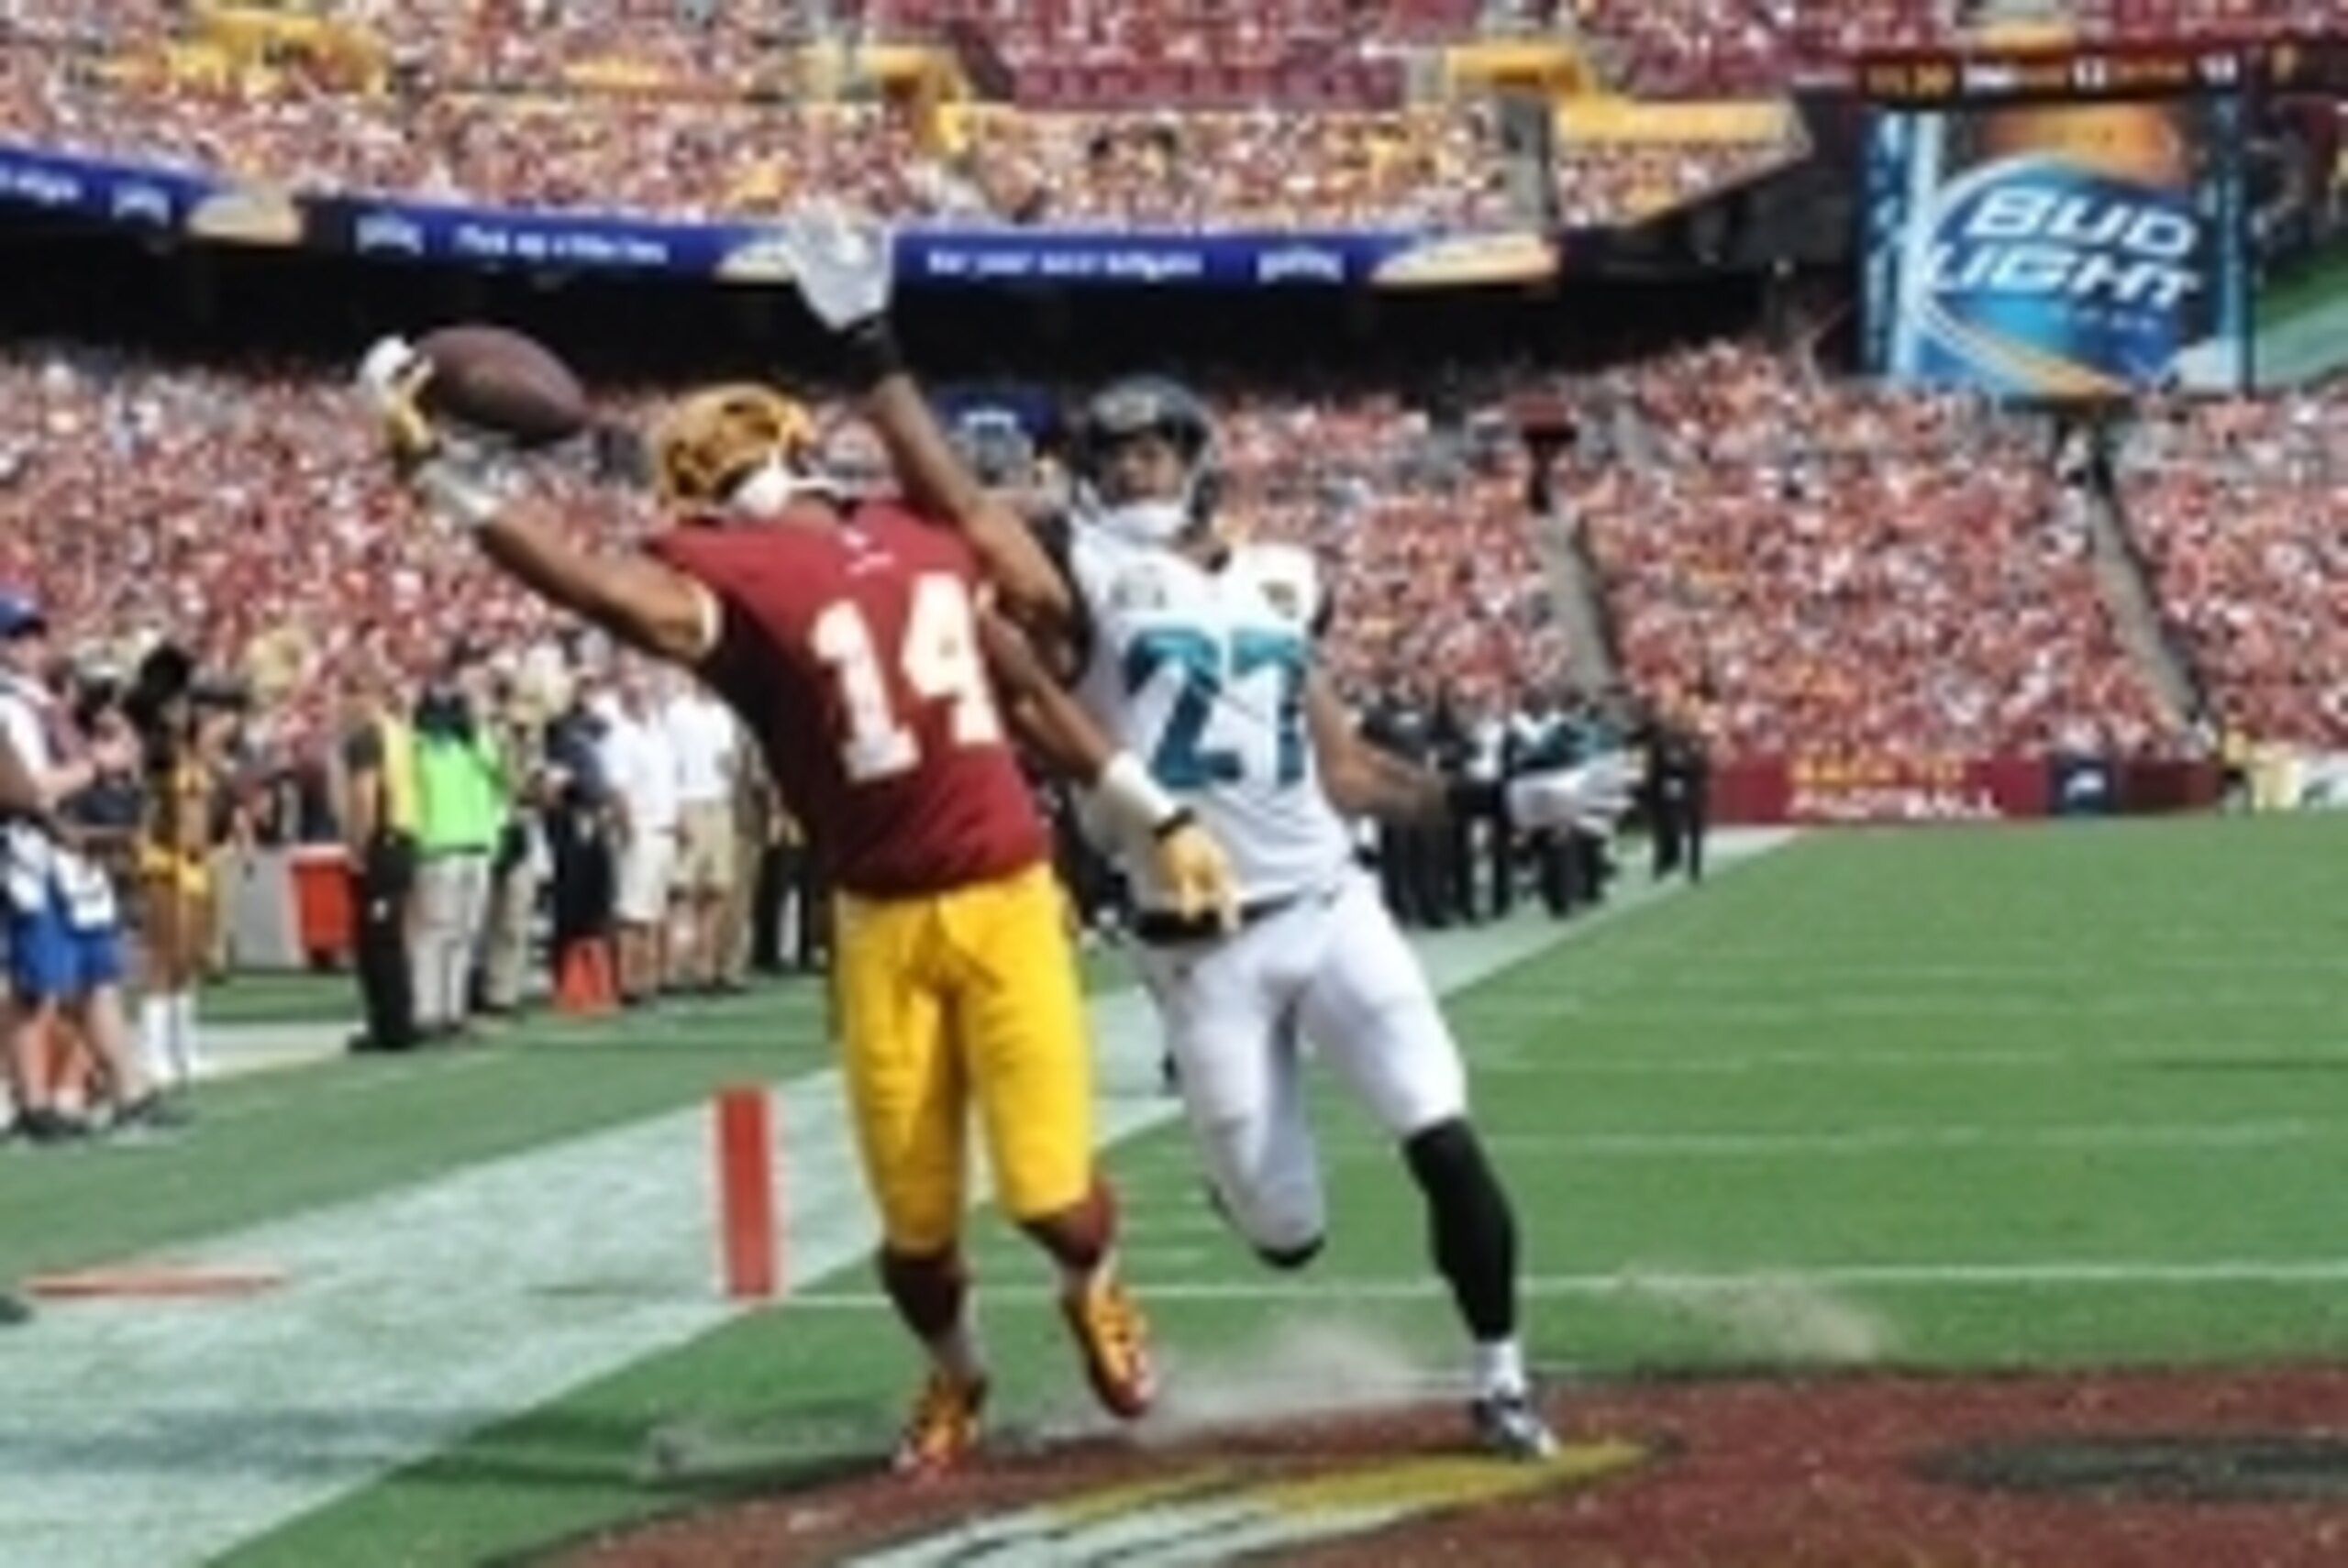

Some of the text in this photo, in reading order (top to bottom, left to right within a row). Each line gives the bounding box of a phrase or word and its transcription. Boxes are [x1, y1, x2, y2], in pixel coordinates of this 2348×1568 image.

[1928, 242, 2201, 309] LIGHT
[1963, 187, 2199, 256] BUD
[811, 570, 1002, 781] 14
[1124, 626, 1308, 790] 27
